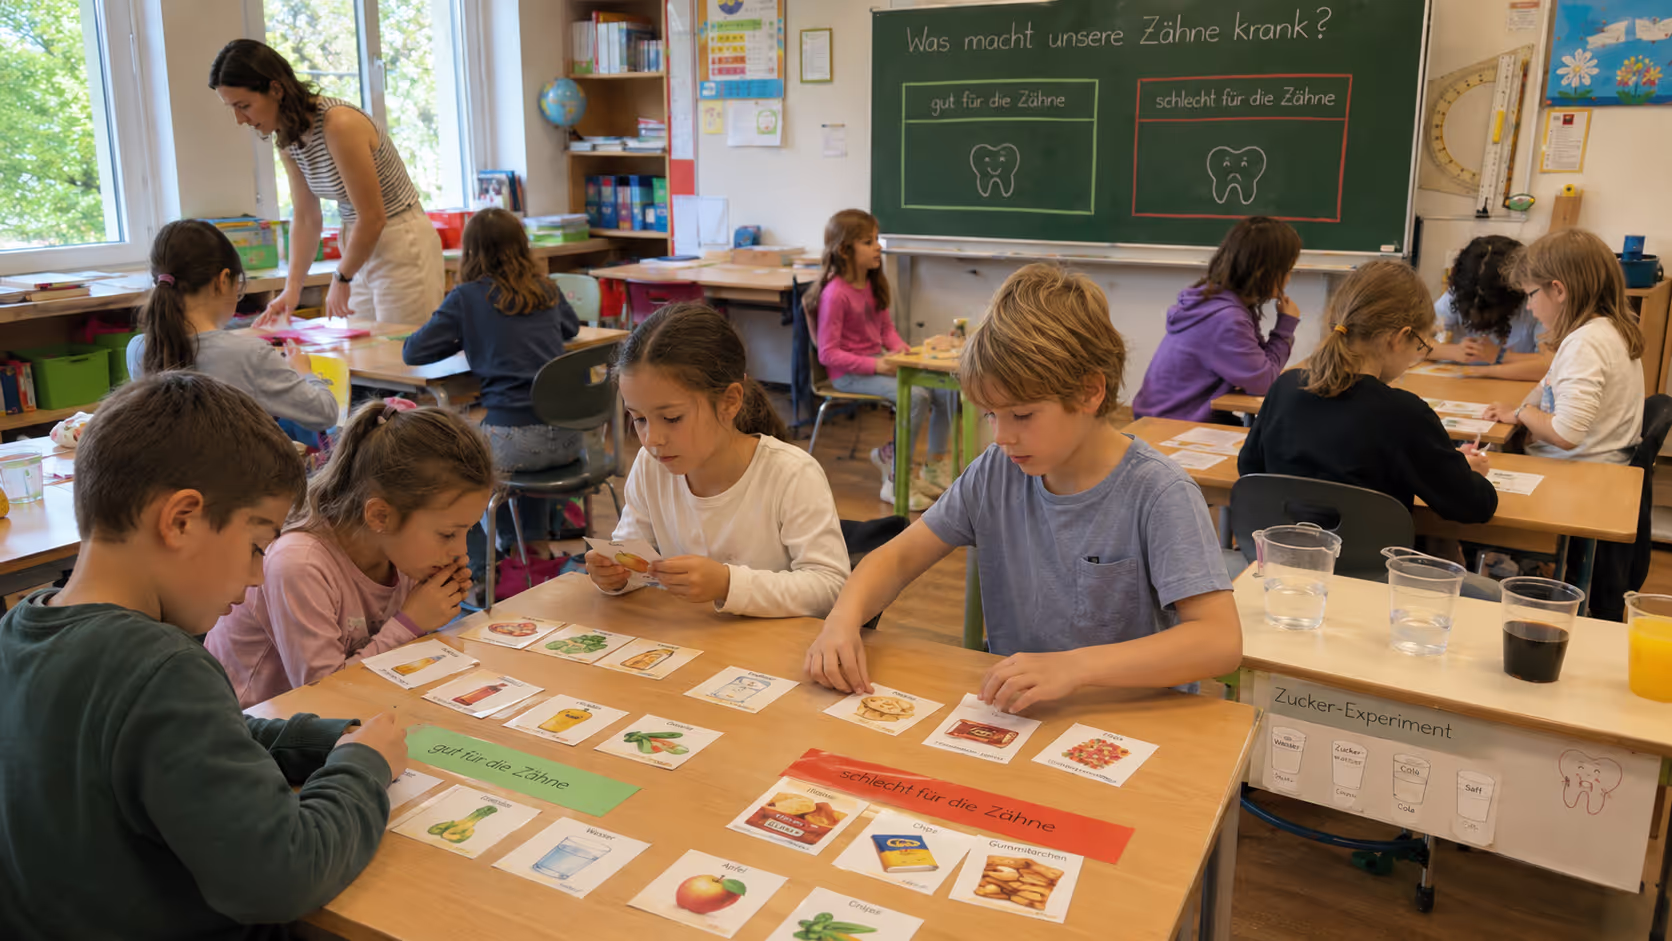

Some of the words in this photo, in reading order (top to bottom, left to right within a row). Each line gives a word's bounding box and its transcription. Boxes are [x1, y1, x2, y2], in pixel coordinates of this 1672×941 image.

[906, 26, 950, 52] Was
[964, 21, 1034, 50] macht
[1048, 28, 1125, 49] unsere
[1139, 14, 1220, 45] Zähne
[931, 93, 955, 117] gut
[962, 89, 984, 108] für
[989, 90, 1012, 108] die
[1017, 89, 1066, 108] Zähne
[1155, 89, 1216, 109] schlecht
[1221, 88, 1243, 107] für
[1249, 87, 1274, 106] die
[1280, 85, 1336, 106] Zähne
[1274, 686, 1453, 740] Zucker-Experiment
[427, 742, 462, 758] gut
[463, 749, 488, 765] für
[485, 758, 512, 773] die
[512, 765, 570, 790] Zähne
[839, 768, 915, 796] schlecht
[915, 786, 947, 804] für
[947, 796, 979, 813] die
[984, 803, 1057, 833] Zähne
